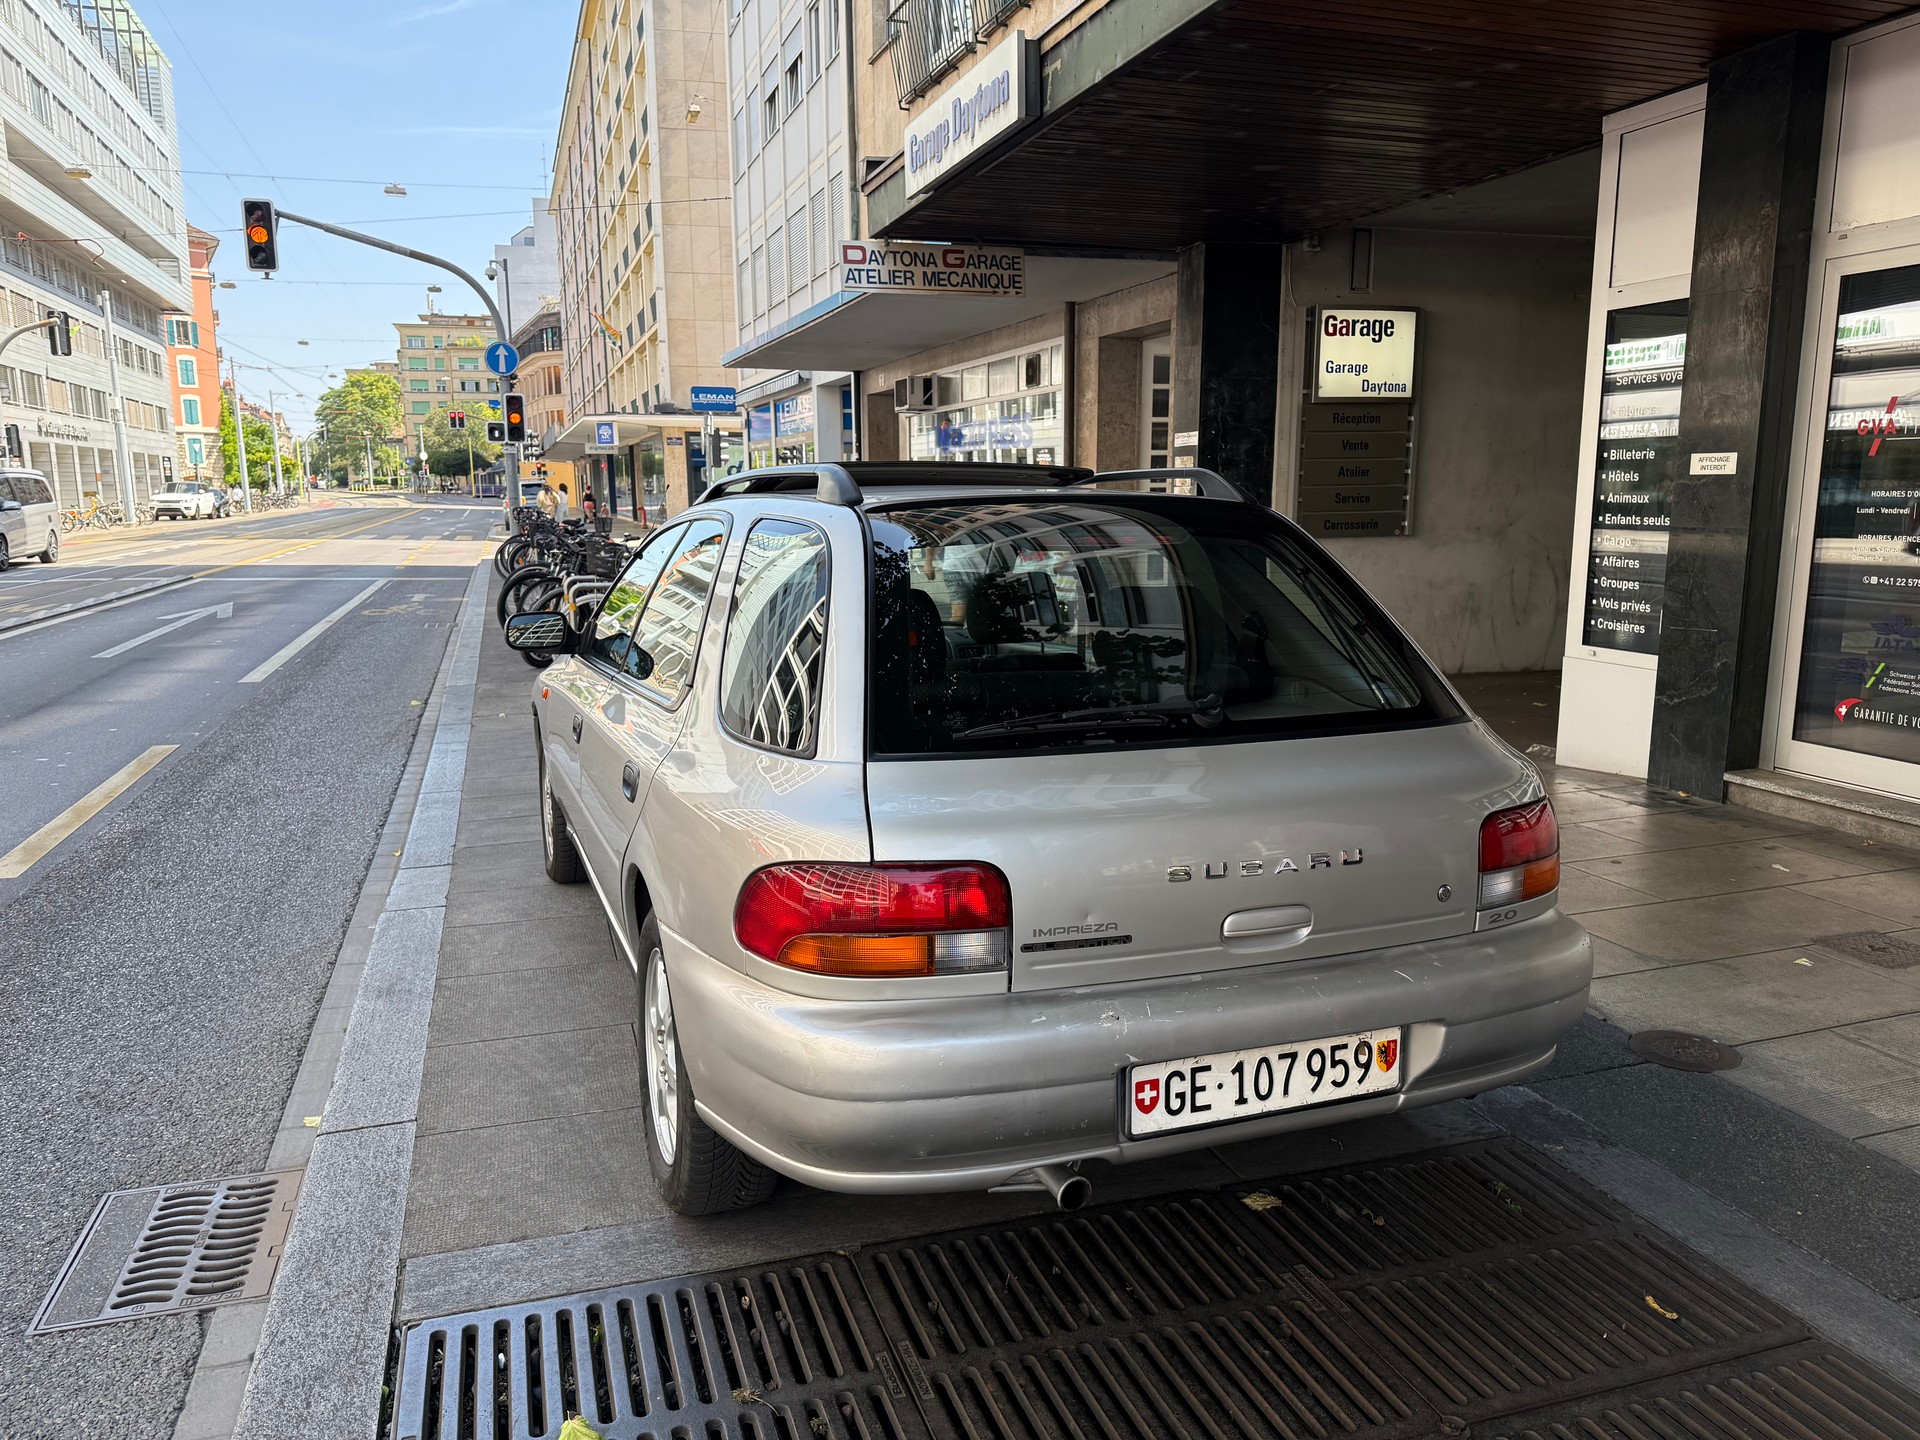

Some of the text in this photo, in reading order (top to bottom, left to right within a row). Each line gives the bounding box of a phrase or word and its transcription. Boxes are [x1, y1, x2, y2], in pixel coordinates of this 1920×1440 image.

[909, 69, 1010, 173] Garage Daytona
[842, 244, 1022, 271] DAYTONA GARAGE
[845, 268, 1023, 290] ATELIER MECANIQUE
[1324, 314, 1395, 343] Garage
[1325, 360, 1369, 376] Garage
[1616, 373, 1658, 386] Services
[1361, 379, 1407, 395] Daytona
[691, 393, 734, 401] LEMAN
[1332, 412, 1381, 426] Réception
[1857, 417, 1897, 436] GVA
[1341, 439, 1370, 451] Vente
[1609, 448, 1656, 460] Billeterie
[1338, 466, 1371, 478] Atelier
[1608, 470, 1640, 482] Hôtels
[1335, 492, 1371, 504] Service
[1607, 492, 1650, 503] Animaux
[1871, 490, 1906, 498] HORAIRES
[1881, 507, 1911, 515] Vendredi
[1323, 519, 1379, 531] Carrosserie
[1605, 513, 1671, 526] Enfants seuls
[1603, 535, 1632, 548] Cargo
[1858, 534, 1892, 542] HORAIRES
[1602, 556, 1640, 568] Affaires
[1600, 576, 1640, 591] Groupes
[1879, 577, 1894, 585] +41
[1896, 578, 1906, 586] 22
[1599, 597, 1651, 613] Vols privés
[1597, 618, 1646, 634] Croisières
[1889, 670, 1917, 680] Schweizer
[1883, 677, 1911, 687] Fédération
[1878, 684, 1910, 695] Federazione
[1854, 707, 1895, 724] GARANTIE
[1897, 713, 1909, 727] DE
[1167, 848, 1364, 883] SUBARU
[1488, 909, 1518, 925] 2.0
[1032, 922, 1118, 938] IMPREZA
